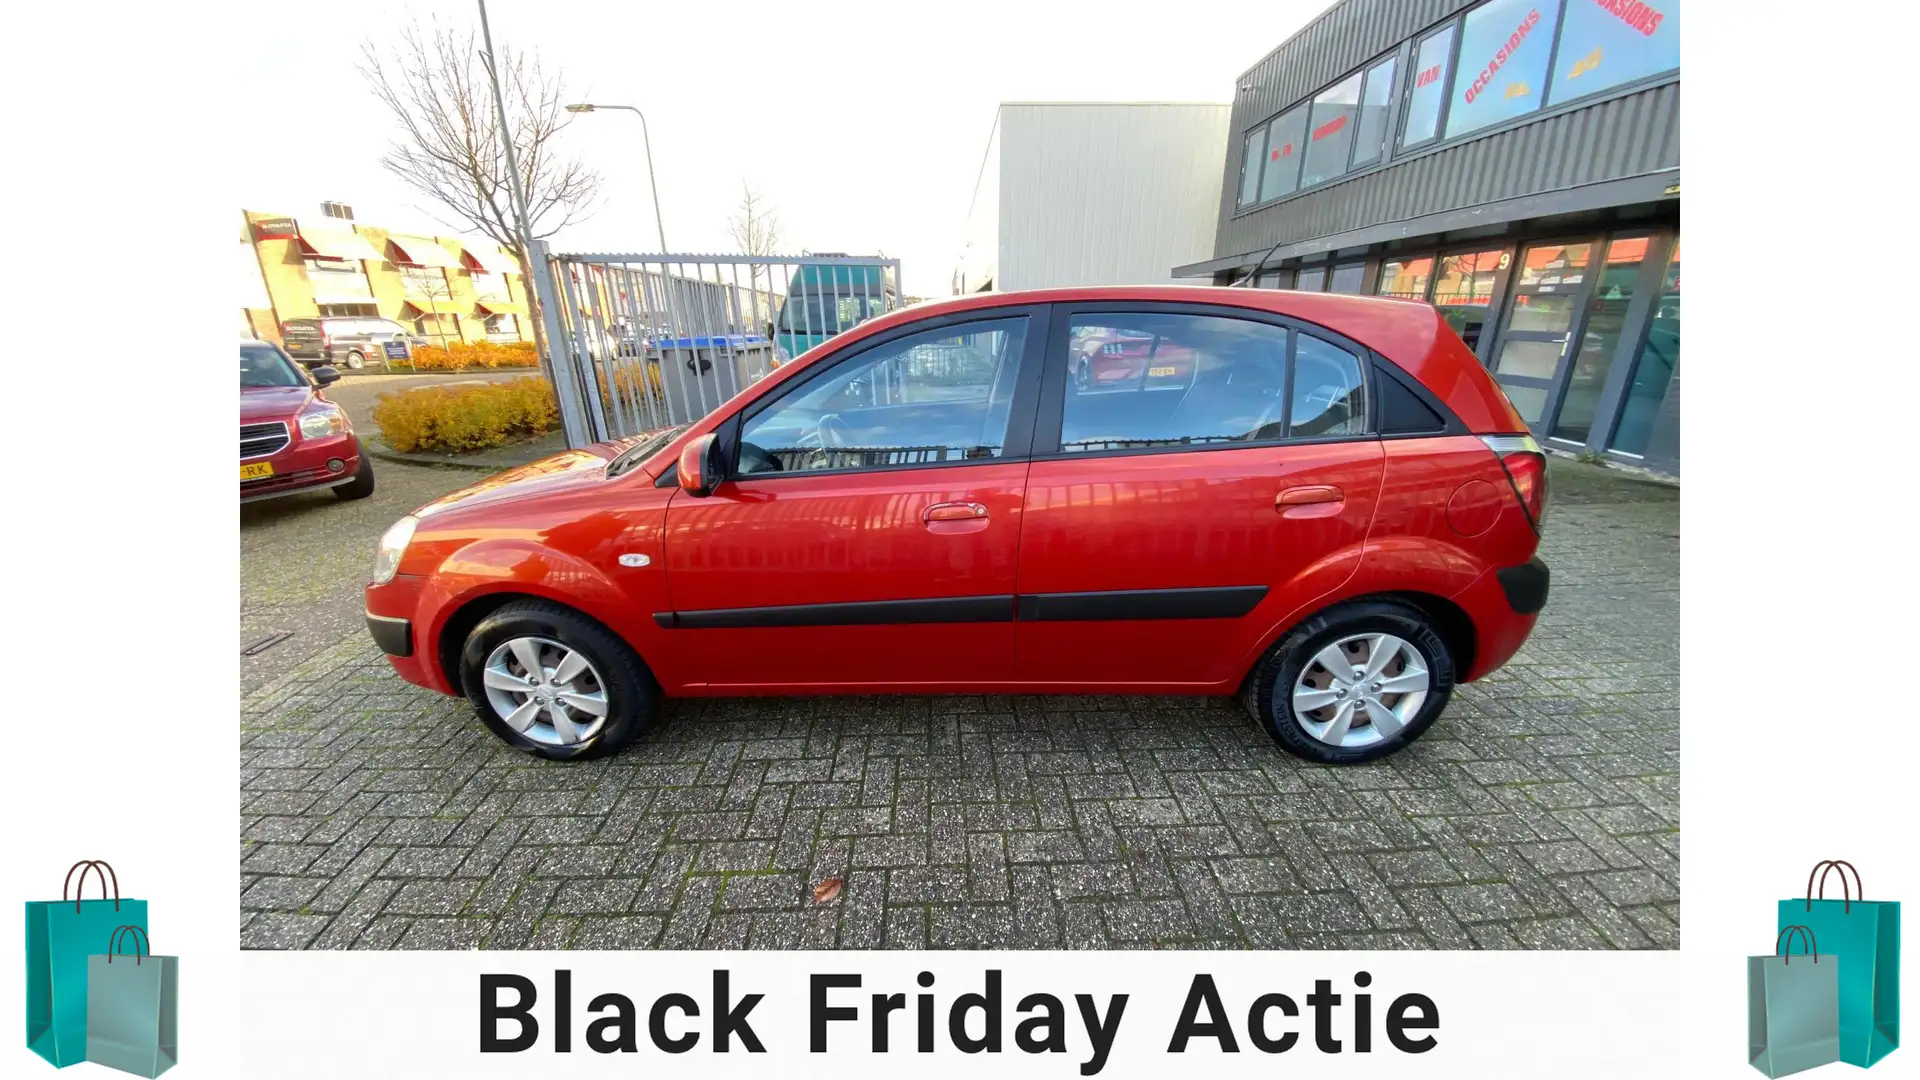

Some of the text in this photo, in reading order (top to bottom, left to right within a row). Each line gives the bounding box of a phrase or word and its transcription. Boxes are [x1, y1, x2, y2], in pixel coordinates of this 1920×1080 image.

[1417, 65, 1441, 88] VAN
[1464, 8, 1540, 104] OCCASIONS
[1499, 253, 1510, 270] 9
